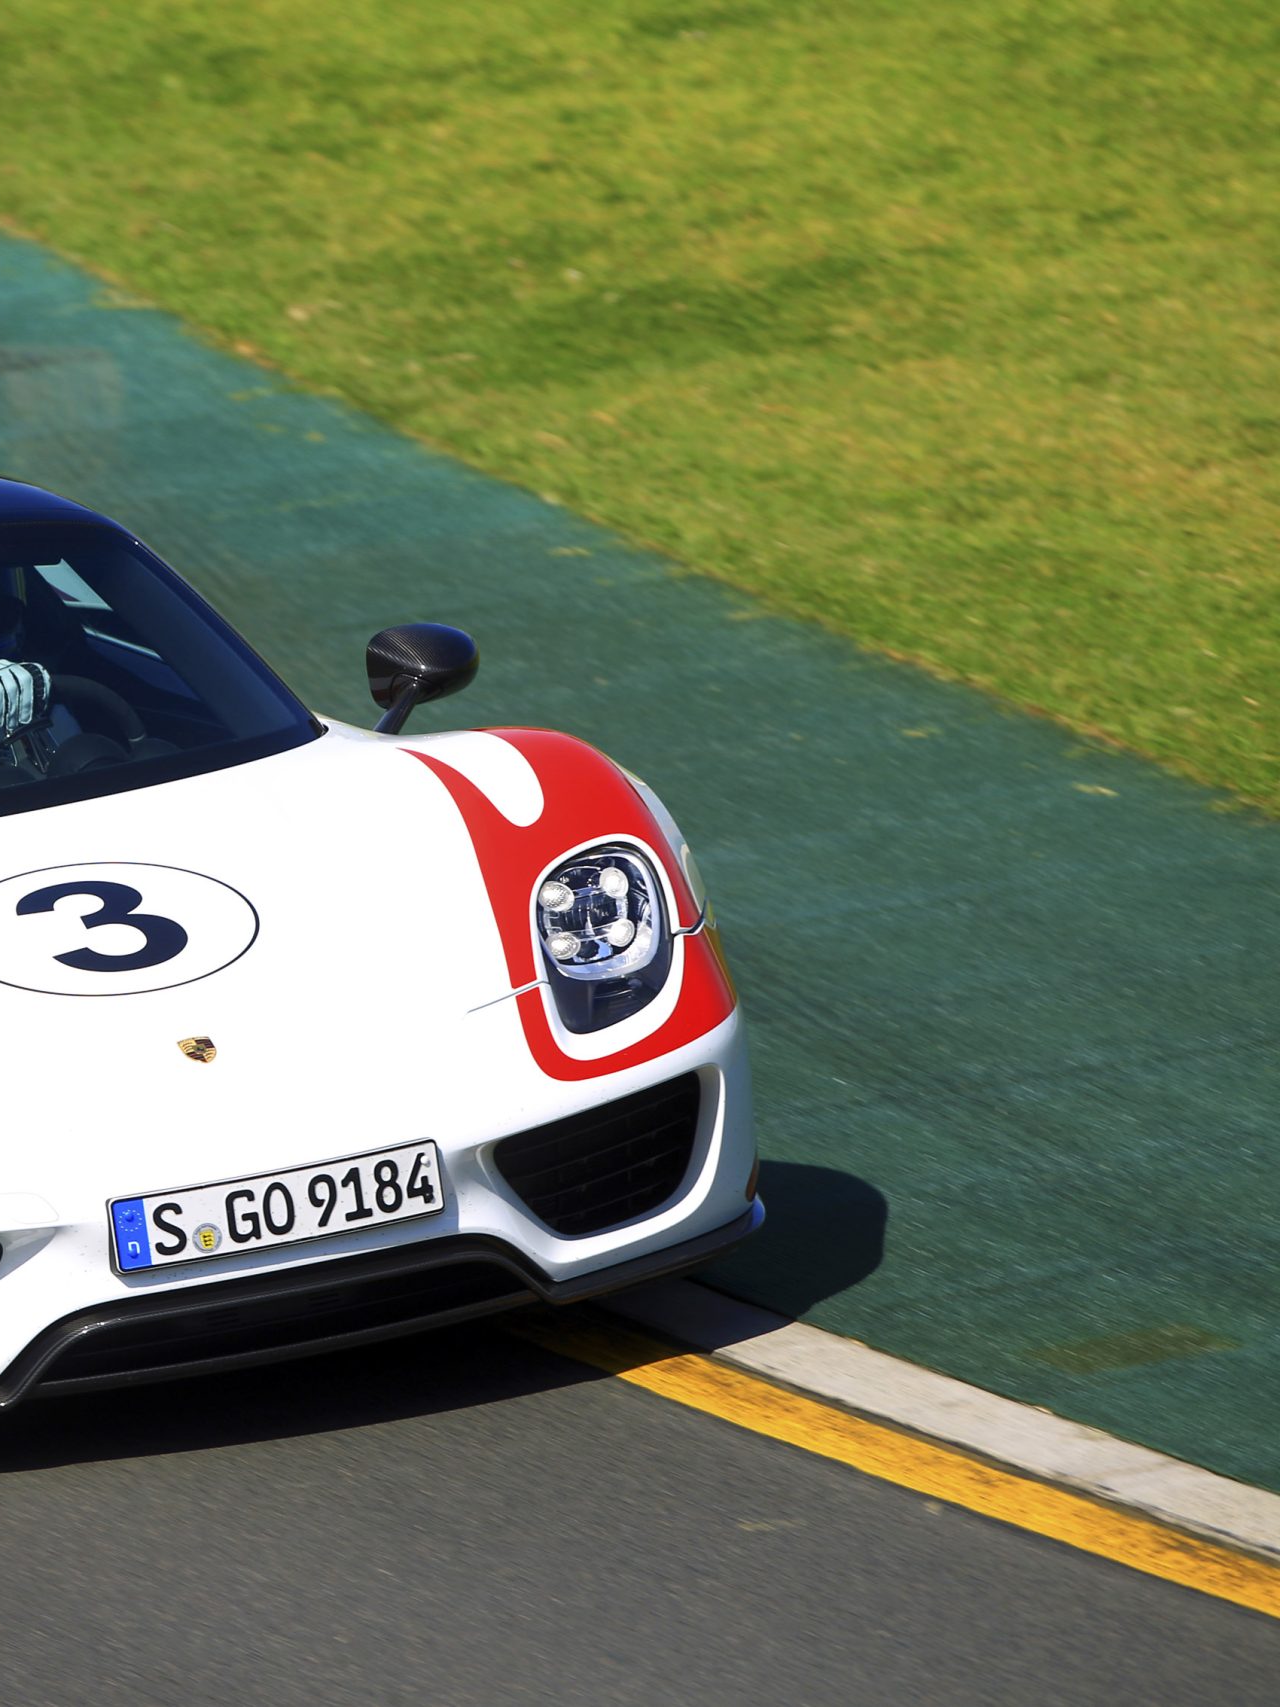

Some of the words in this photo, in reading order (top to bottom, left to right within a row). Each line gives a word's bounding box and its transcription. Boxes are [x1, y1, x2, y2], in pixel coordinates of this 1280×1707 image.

[16, 880, 189, 972] 3
[152, 1202, 188, 1256] S
[225, 1181, 295, 1244] GO
[307, 1151, 434, 1228] 9184
